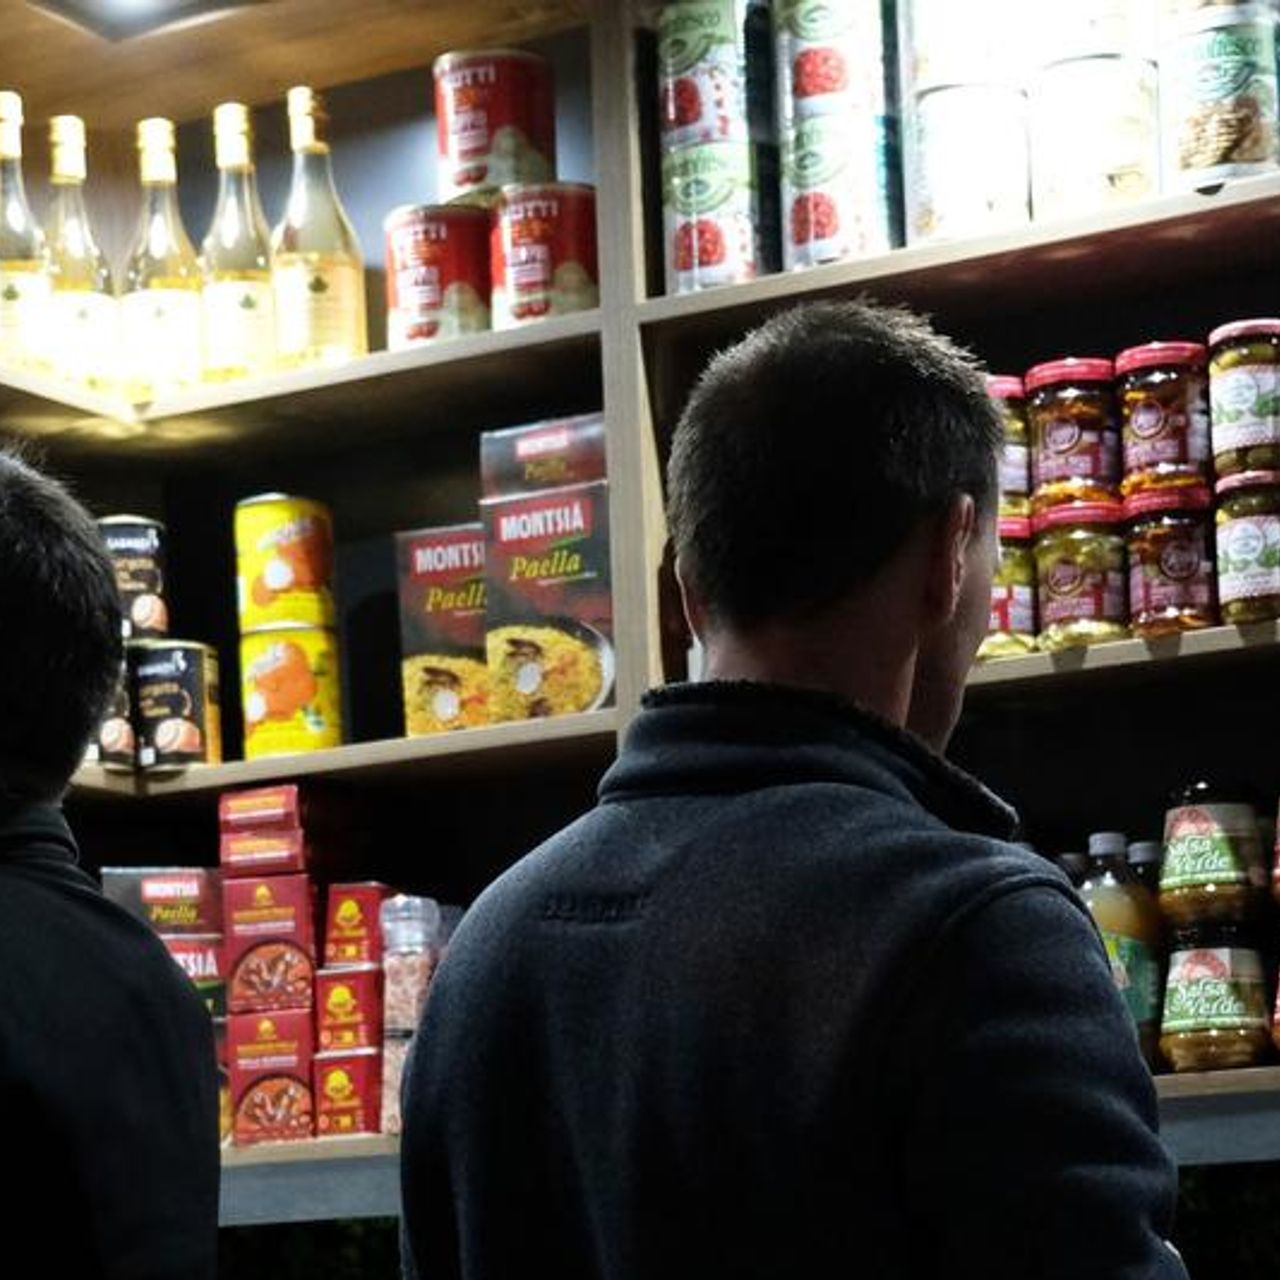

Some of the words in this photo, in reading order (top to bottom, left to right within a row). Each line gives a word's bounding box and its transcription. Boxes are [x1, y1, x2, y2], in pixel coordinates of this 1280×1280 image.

[415, 541, 486, 574] MONTSI
[509, 550, 582, 581] Paella
[426, 582, 488, 612] Paell
